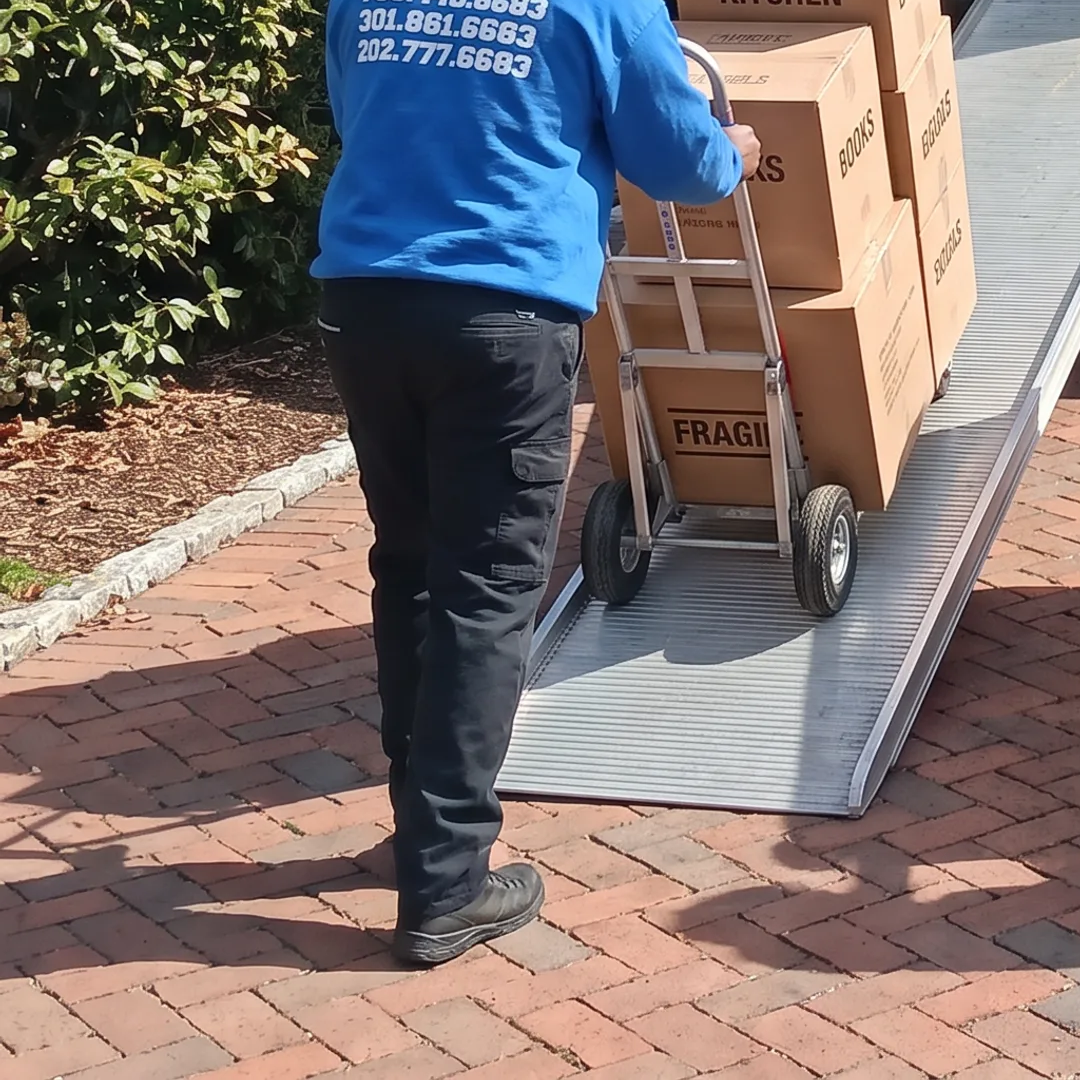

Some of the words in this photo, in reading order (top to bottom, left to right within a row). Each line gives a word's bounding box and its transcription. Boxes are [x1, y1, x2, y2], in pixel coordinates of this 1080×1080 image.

[357, 38, 533, 79] 202.777.6683
[838, 107, 875, 180] BOOKS
[673, 418, 804, 449] FRAGI
